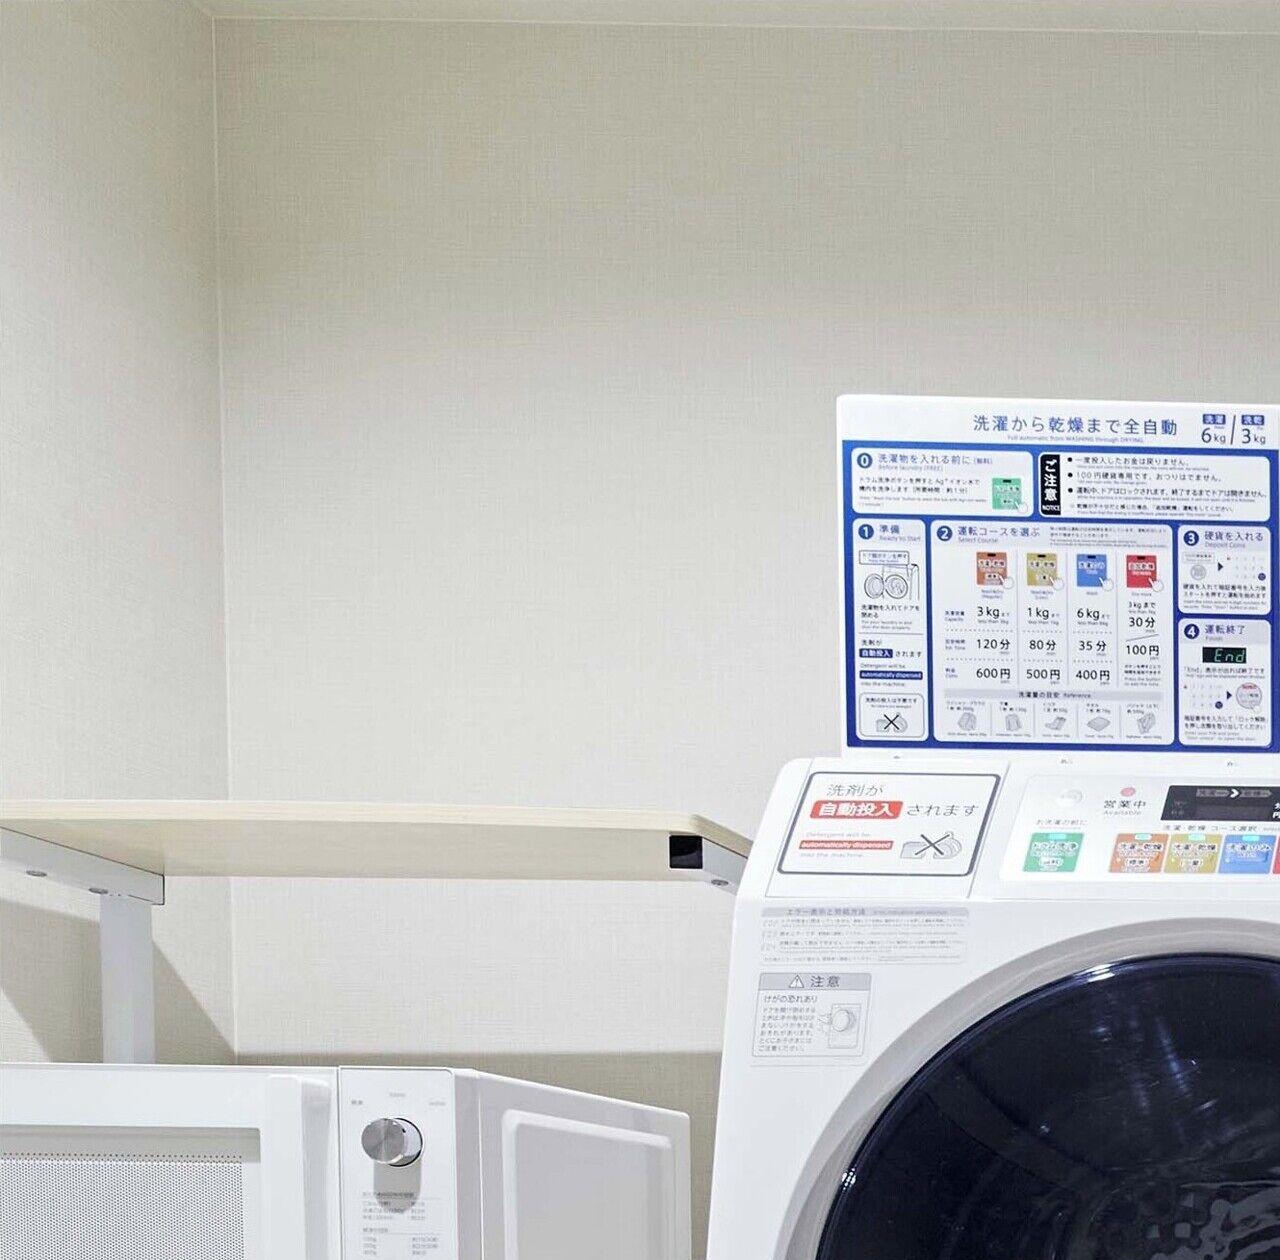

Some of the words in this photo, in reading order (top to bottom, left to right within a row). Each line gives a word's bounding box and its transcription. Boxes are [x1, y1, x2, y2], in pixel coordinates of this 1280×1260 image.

[973, 414, 1178, 436] 洗濯から乾燥まで全自動
[1043, 458, 1058, 502] ご注意
[957, 526, 1041, 538] 運転コースを選ぶ
[1204, 530, 1264, 541] 硬貨を入れる
[1205, 624, 1246, 635] 運転終了
[1214, 648, 1246, 663] End
[826, 783, 884, 797] 洗剤が
[818, 802, 895, 817] 自動投入
[906, 803, 979, 817] されます
[801, 841, 851, 850] automatically
[852, 841, 892, 850] dispensed
[810, 974, 841, 988] 注意
